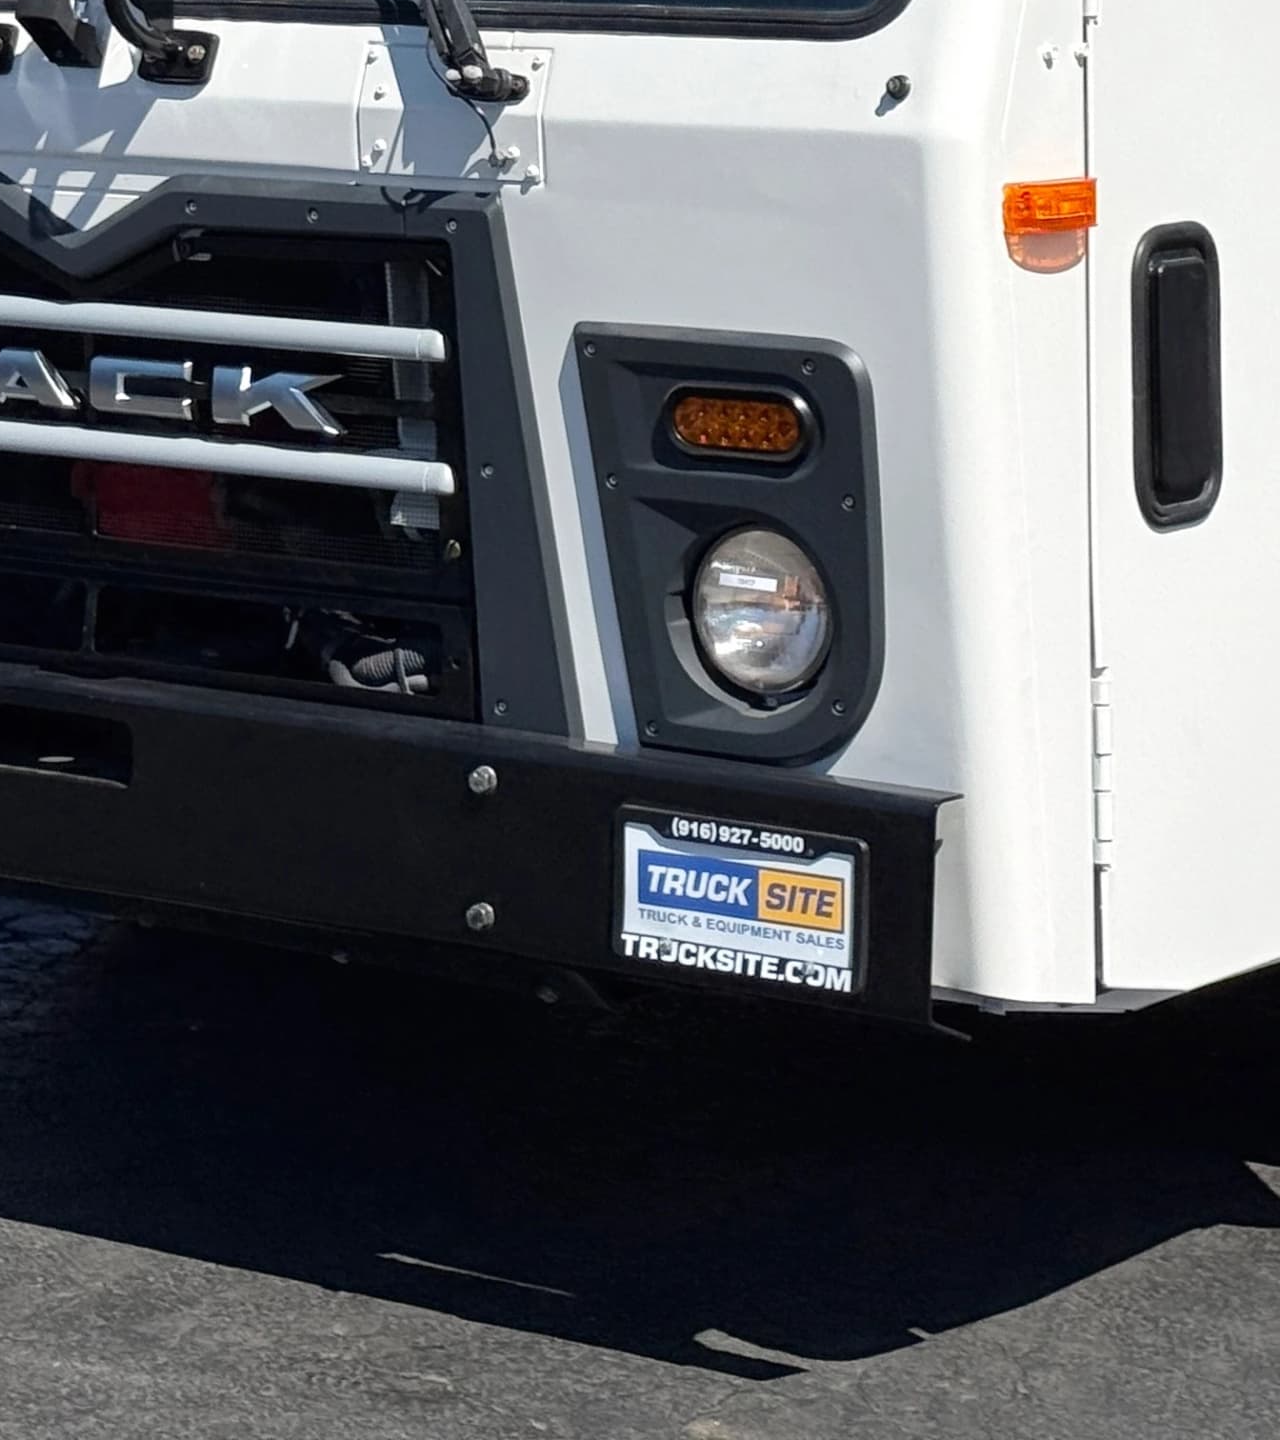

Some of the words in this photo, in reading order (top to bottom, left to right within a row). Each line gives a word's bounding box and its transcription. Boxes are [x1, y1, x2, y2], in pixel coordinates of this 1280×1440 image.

[646, 864, 754, 907] TRUCK
[765, 882, 837, 919] SITE
[638, 908, 689, 927] TRUCK
[691, 915, 703, 929] &
[705, 917, 792, 943] EQUIPMENT
[795, 932, 846, 951] SALES
[620, 932, 853, 993] TRUCKSITE.COM
